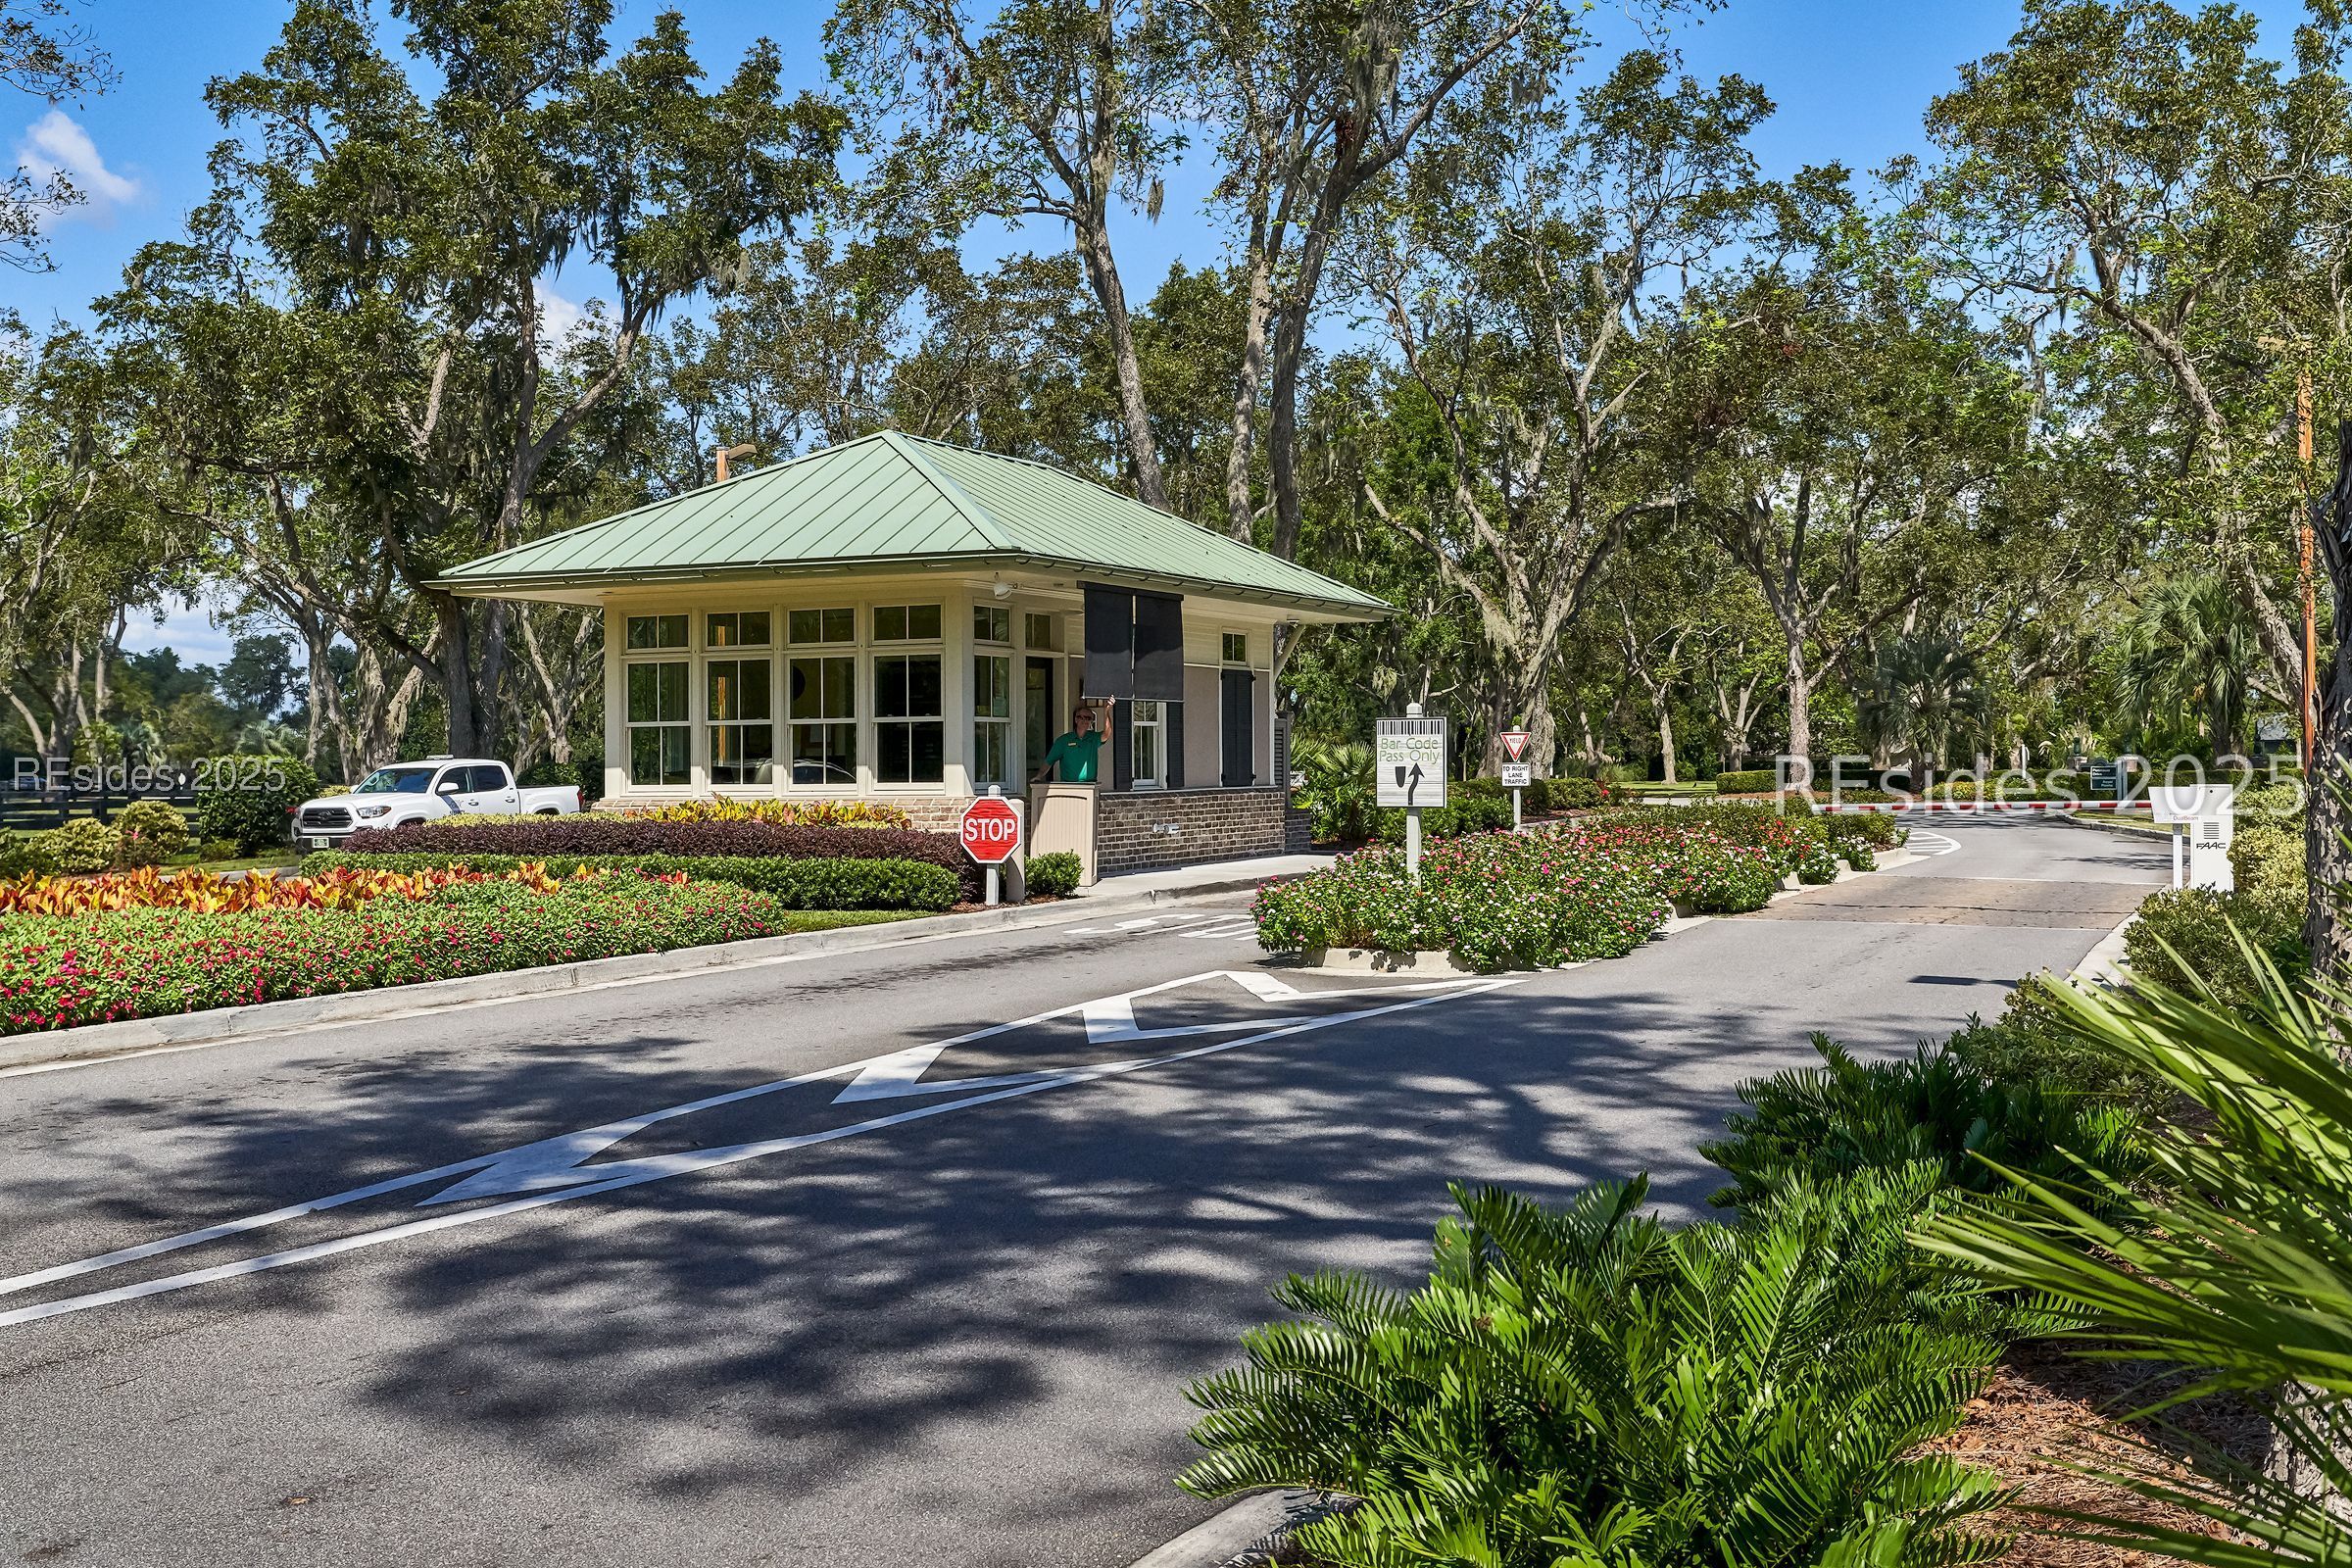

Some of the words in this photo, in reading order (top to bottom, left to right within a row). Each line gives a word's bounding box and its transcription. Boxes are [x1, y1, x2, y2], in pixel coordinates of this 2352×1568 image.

[1381, 737, 1401, 750] Bar
[1405, 737, 1439, 750] Code
[1379, 750, 1404, 762] Pass
[1409, 749, 1441, 765] Only
[964, 818, 1015, 842] STOP
[2195, 841, 2227, 850] FAAC
